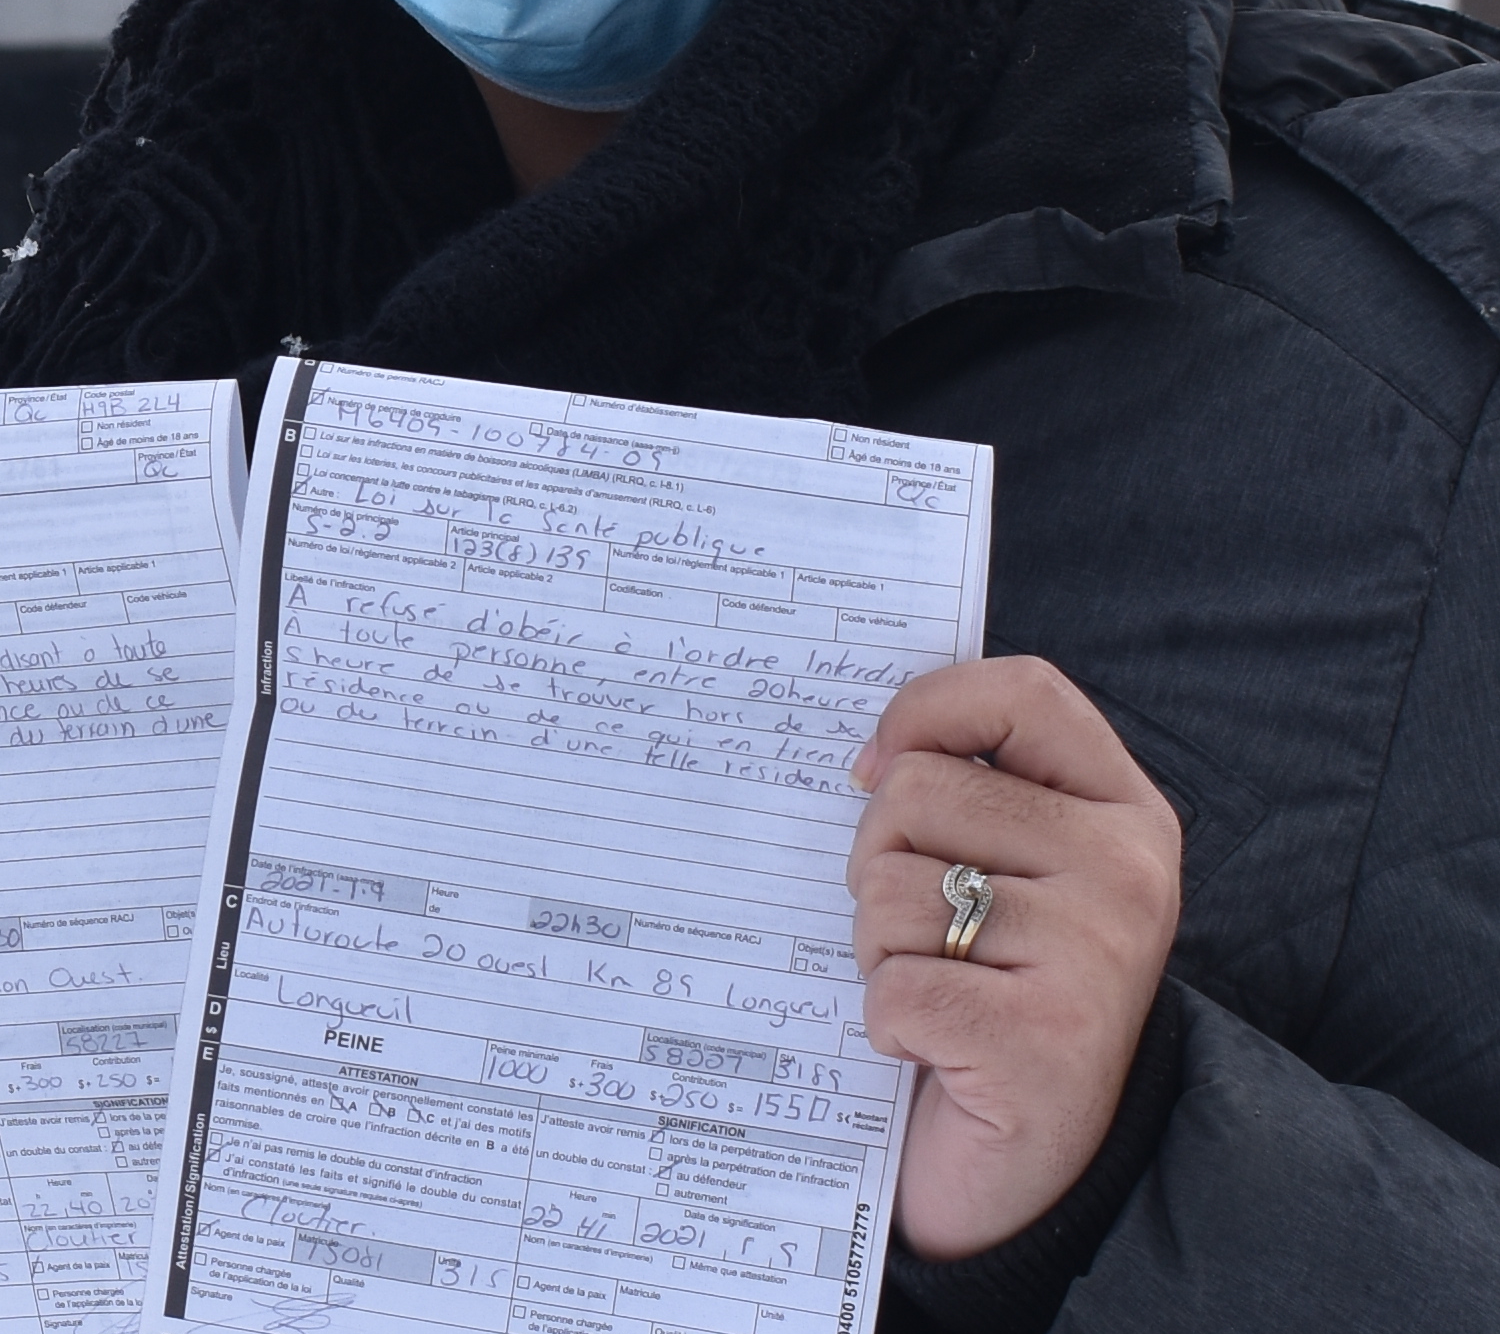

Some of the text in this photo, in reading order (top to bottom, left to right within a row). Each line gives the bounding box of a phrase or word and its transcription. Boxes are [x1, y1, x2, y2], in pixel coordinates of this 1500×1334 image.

[283, 427, 298, 444] B
[354, 483, 399, 506] Loi
[632, 519, 766, 569] publique
[260, 640, 273, 695] Infraction
[339, 619, 415, 650] toute
[633, 664, 717, 689] entre
[279, 697, 316, 714] ou
[336, 701, 379, 722] du
[549, 676, 656, 712] trouver
[686, 698, 744, 725] hors
[774, 712, 804, 733] de
[455, 701, 491, 715] ou
[526, 709, 560, 725] de
[595, 720, 625, 734] ce
[647, 728, 693, 752] qui
[718, 737, 752, 753] en
[225, 894, 239, 909] C
[245, 901, 400, 953] Autoroute
[421, 933, 467, 963] 20
[215, 941, 231, 970] Lieu
[208, 1002, 224, 1018] D
[201, 1045, 216, 1063] E
[323, 1028, 385, 1055] PEINE
[20, 1075, 63, 1092] 300
[96, 1072, 138, 1089] 250
[337, 1064, 421, 1090] ATTESTATION
[211, 1115, 263, 1132] commise.
[214, 1097, 530, 1157] raisonnables de croire que l'infraction décrite en B a été
[539, 1113, 646, 1140] J'atteste avoir remis
[656, 1114, 748, 1140] SIGNIFICATION
[226, 1135, 483, 1188] Je n'ai pas remis le double du constat d'infraction
[535, 1149, 647, 1175] un double du constat
[668, 1133, 859, 1175] lors de la perpétration de l'infraction
[222, 1166, 280, 1185] d'infraction
[224, 1152, 522, 1212] J'ai constaté les faits et signifié le double du constat
[666, 1152, 850, 1191] après la perpétration de l'infraction
[675, 1168, 748, 1192] au défendeur
[175, 1112, 206, 1271] Attestation/Signification
[673, 1189, 728, 1206] autrement
[843, 1200, 872, 1299] 5105772779
